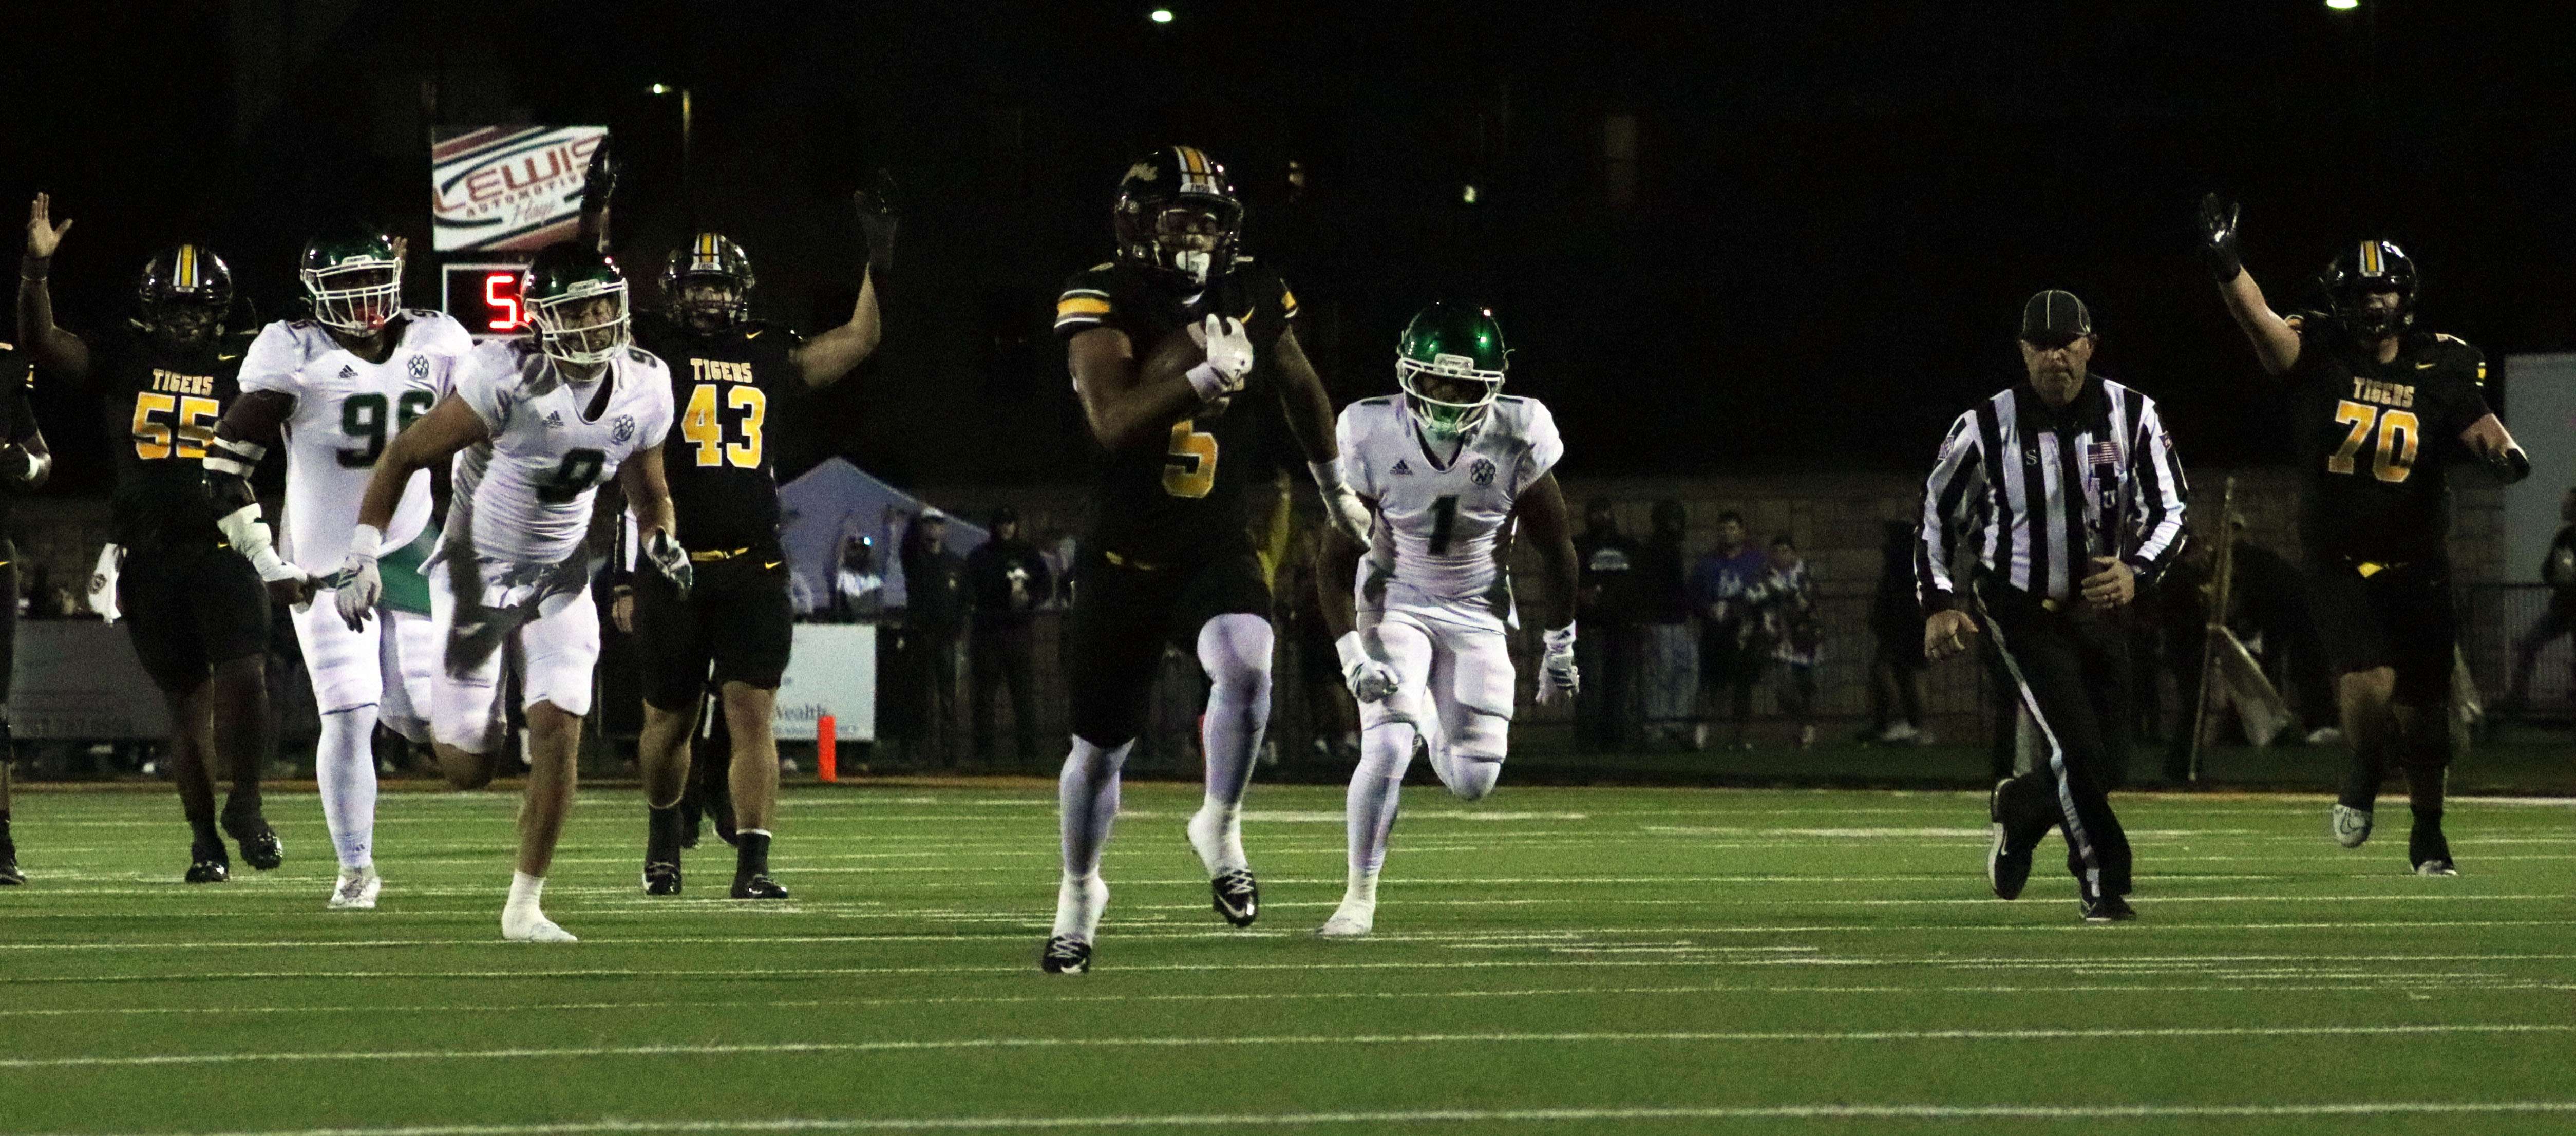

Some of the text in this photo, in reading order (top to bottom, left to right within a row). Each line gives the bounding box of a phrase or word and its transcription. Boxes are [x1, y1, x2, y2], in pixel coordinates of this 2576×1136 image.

[433, 134, 603, 213] LEWIS
[466, 168, 585, 218] AUTOMOTIV
[152, 368, 214, 396] TIGERS
[690, 358, 752, 383] TIGERS
[2353, 376, 2415, 408] TIGERS
[132, 391, 219, 460] 55
[681, 384, 766, 469] 43
[2328, 399, 2419, 483] 70
[1162, 419, 1218, 498] 5
[1427, 495, 1460, 556] 1
[776, 703, 827, 720] ealth
